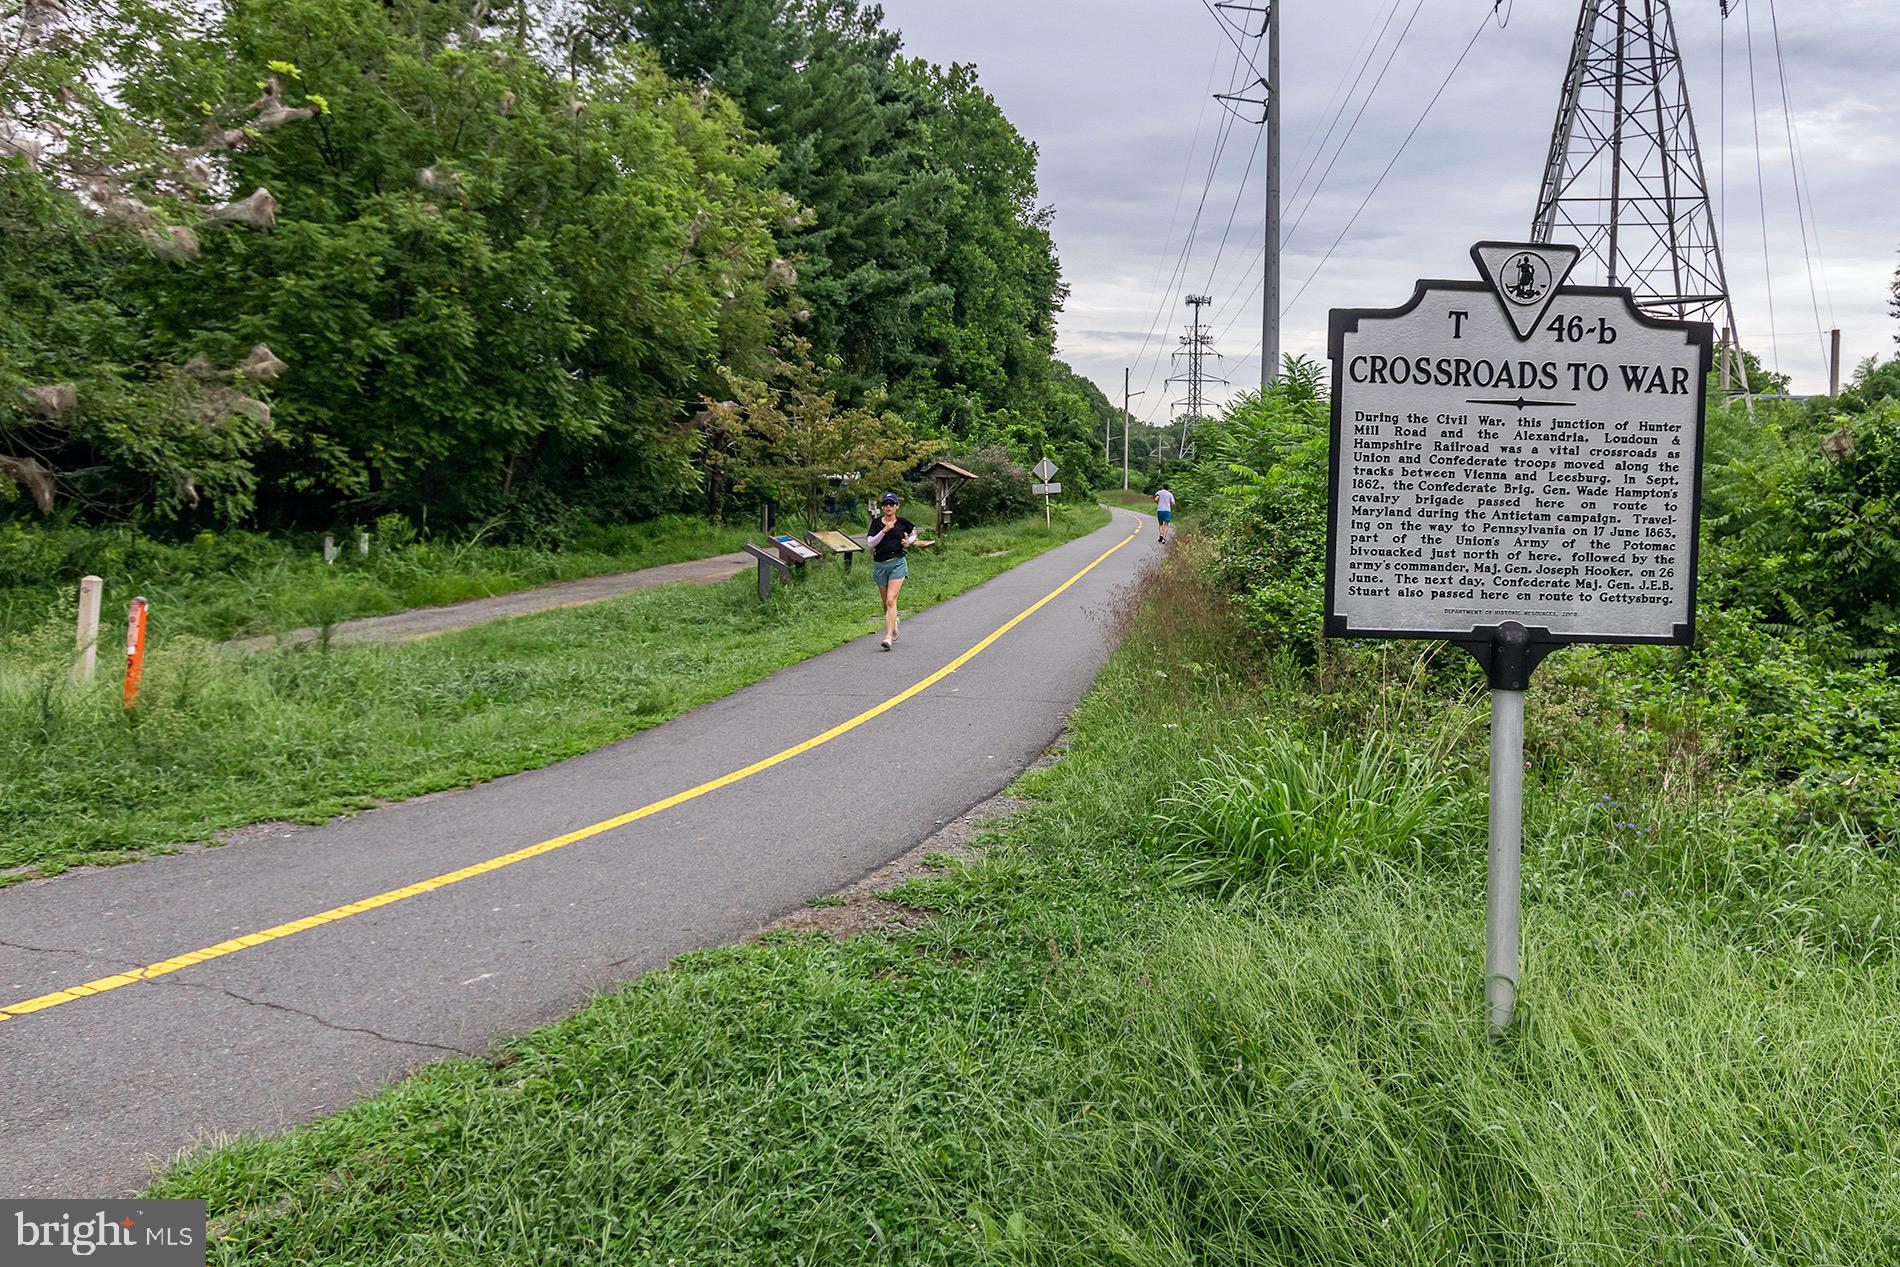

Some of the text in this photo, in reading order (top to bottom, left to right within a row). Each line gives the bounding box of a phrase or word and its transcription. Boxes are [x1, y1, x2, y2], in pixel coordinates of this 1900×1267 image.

[1448, 310, 1617, 344] T 46-b
[1349, 355, 1689, 394] CROSSROADS TO WAR
[1355, 411, 1682, 433] During the Civil War, this junction of Hunter
[1354, 424, 1681, 446] Mill Road and the Alexandria, Loudoun &
[1353, 438, 1680, 459] Hampshire Railroad was a vital crossroads as
[1353, 451, 1680, 474] Union and Confederate troops moved along the
[1353, 465, 1679, 488] tracks between Vienna and Leesburg. In Sept.
[1352, 478, 1678, 500] 1862, the Confederate Brig. Gen. Wade Hampton's
[1352, 492, 1678, 512] cavalry brigade passed here on route to
[1351, 505, 1677, 526] Maryland during the Antietam campaign. Travel-
[1350, 517, 1676, 539] ing on the way to Pennsylvania on 17 June 1863,
[1350, 532, 1676, 553] part of the Union's Army of the Potomac
[1349, 544, 1423, 558] bivouacked
[1429, 548, 1456, 560] just
[1462, 549, 1499, 561] north
[1507, 550, 1522, 561] of
[1571, 552, 1626, 565] followed
[1631, 552, 1649, 565] by
[1653, 553, 1675, 565] the
[1349, 559, 1674, 579] army's commander, Maj. Gen. Joseph Hooker, on 26
[1348, 572, 1674, 592] June. The next day, Confederate Maj. Gen. J.E.B.
[1348, 585, 1673, 606] Stuart also passed here en route to Gettysburg.
